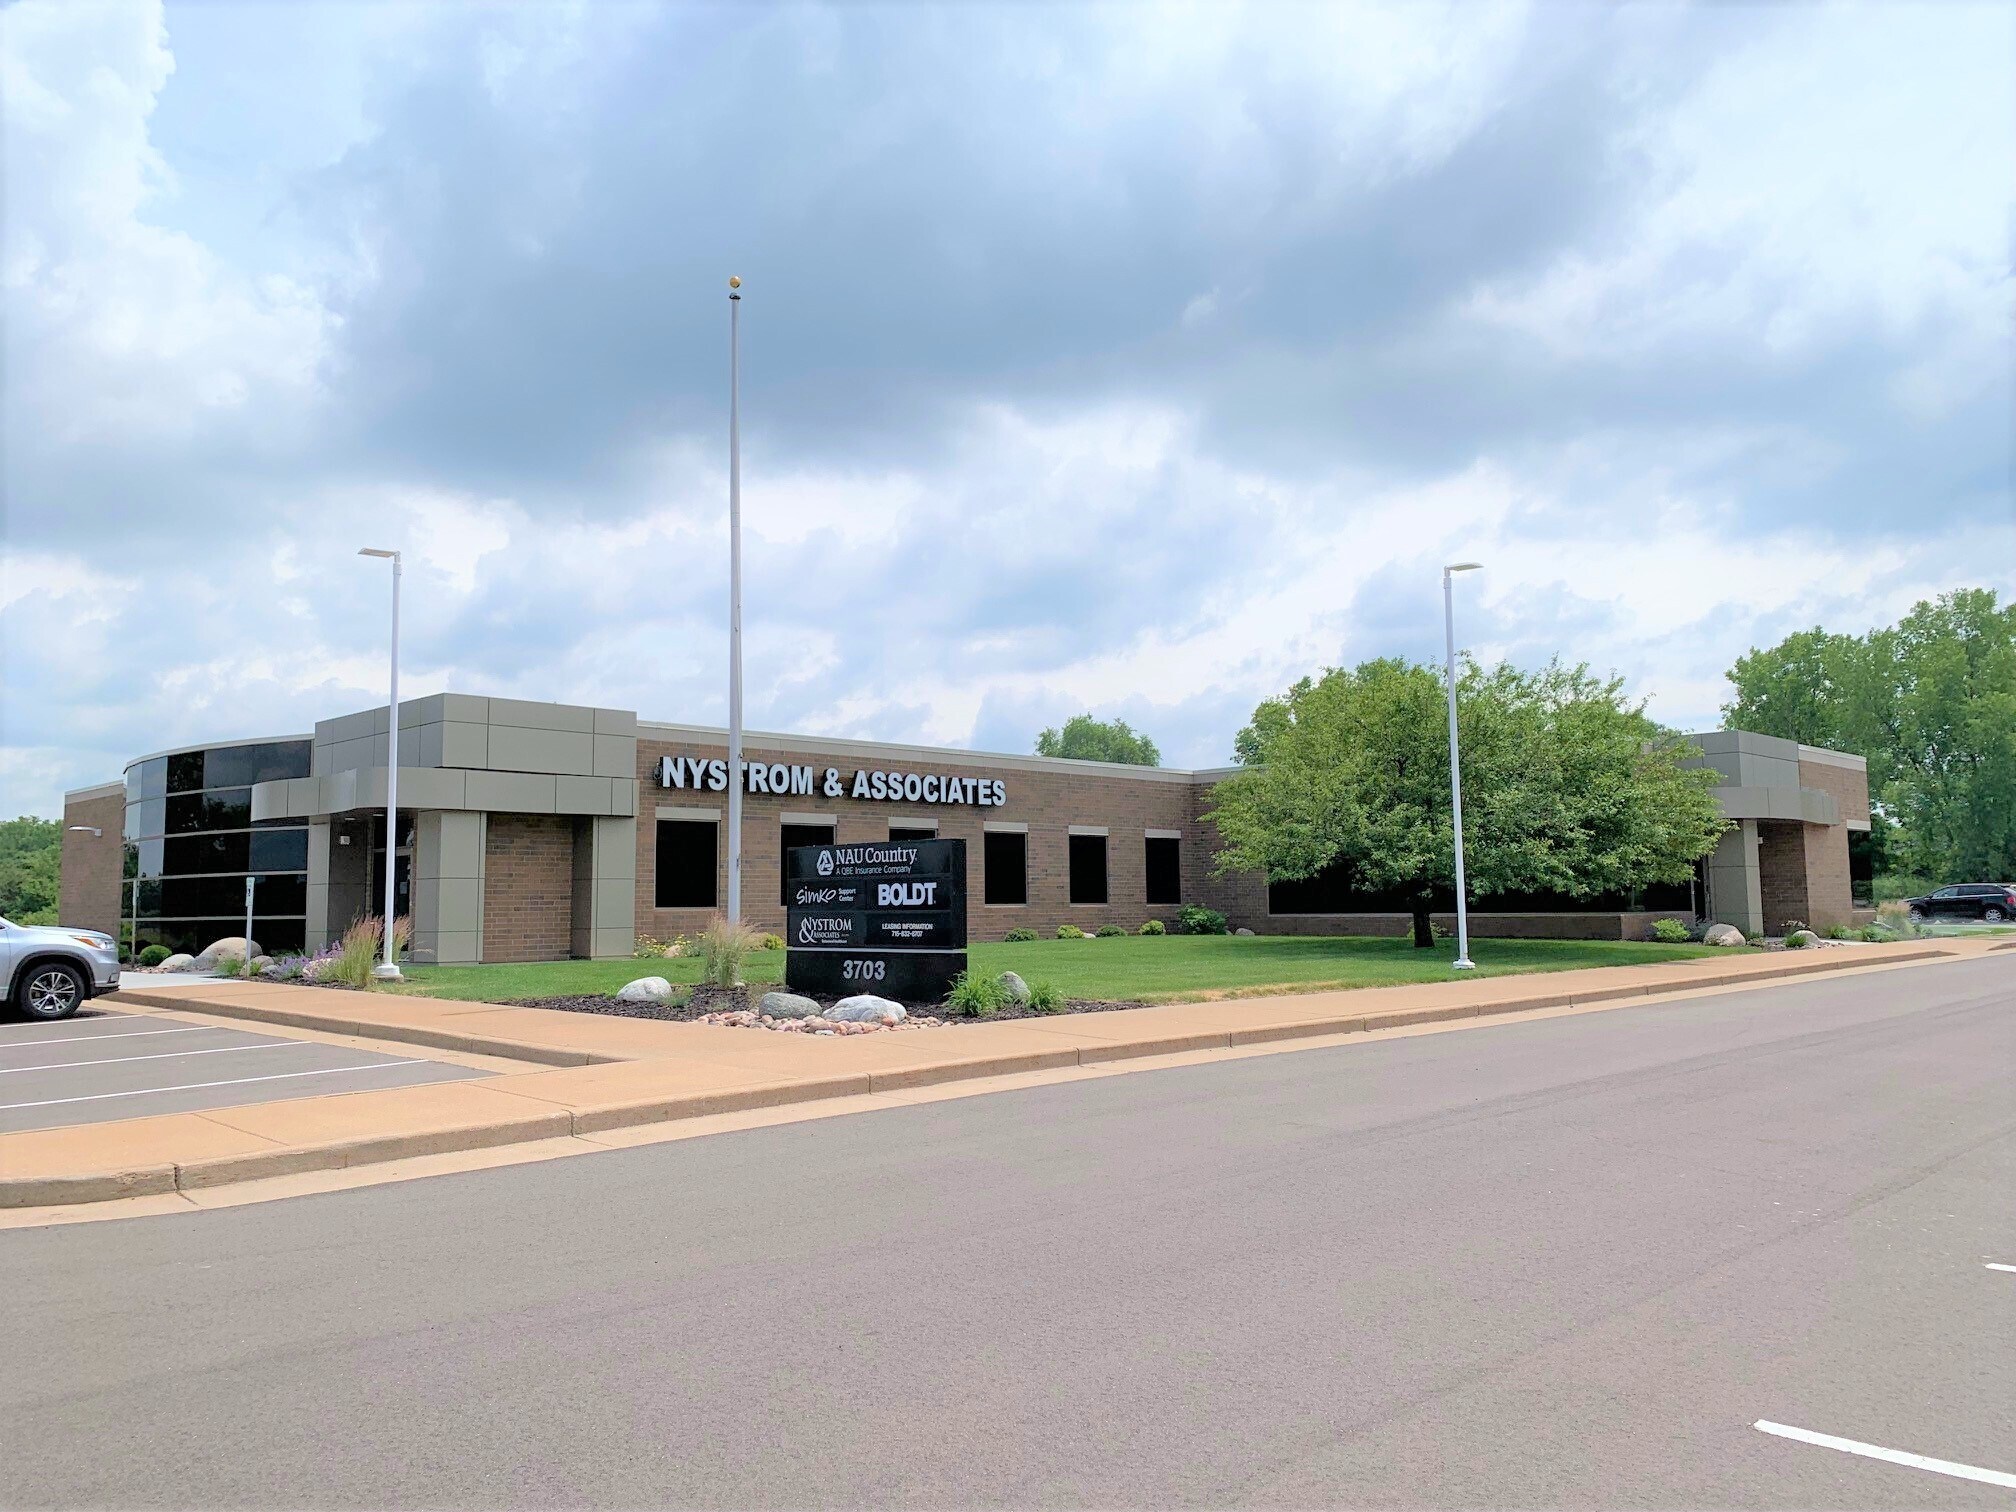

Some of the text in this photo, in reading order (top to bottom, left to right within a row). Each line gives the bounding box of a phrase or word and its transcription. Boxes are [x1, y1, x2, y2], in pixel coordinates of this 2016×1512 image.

[662, 756, 1007, 807] NYSROM & ASSOCIATES
[836, 847, 917, 865] NAU Country
[836, 867, 841, 875] A
[855, 866, 882, 875] Insurance
[883, 864, 912, 875] Company
[878, 882, 937, 906] BOLDT
[804, 916, 853, 931] NYSTROM
[881, 922, 934, 930] LEASING INFORMATION
[813, 931, 840, 939] ASSOCIATES
[843, 960, 886, 980] 3703
